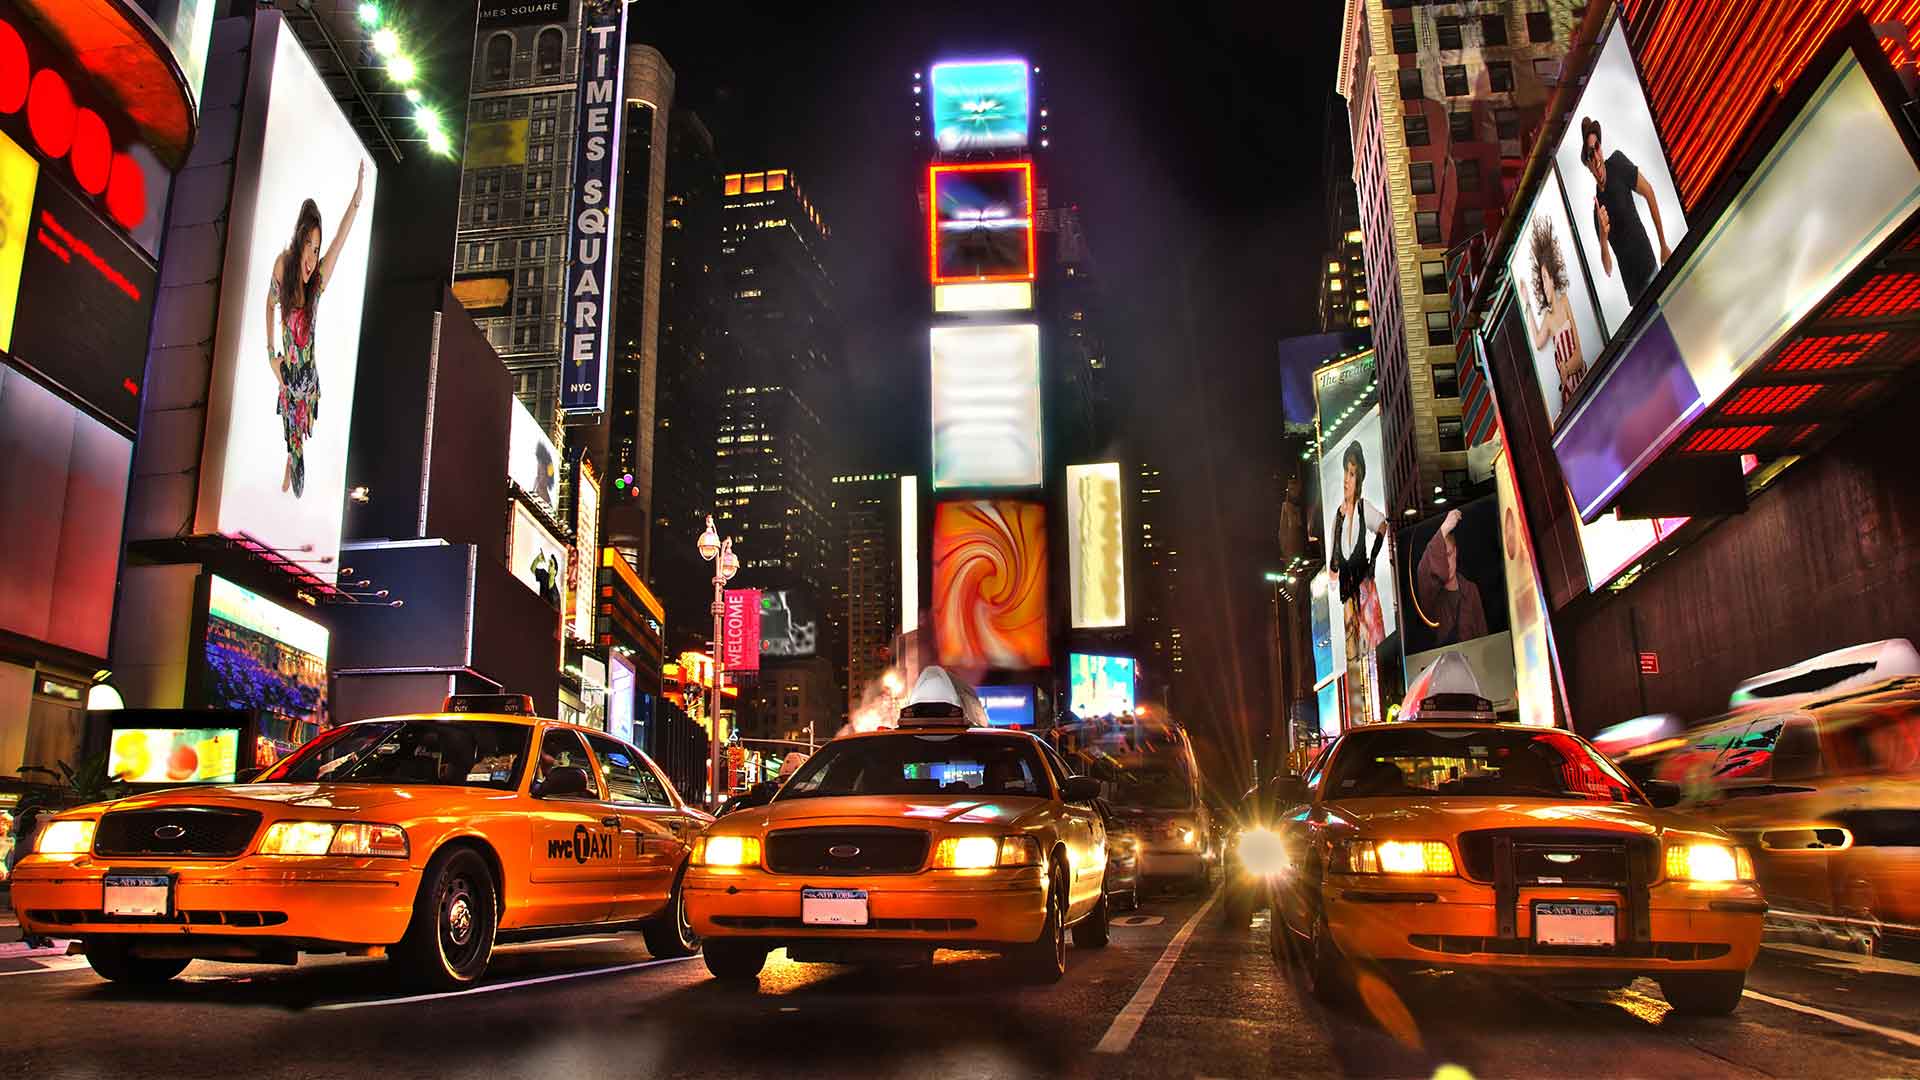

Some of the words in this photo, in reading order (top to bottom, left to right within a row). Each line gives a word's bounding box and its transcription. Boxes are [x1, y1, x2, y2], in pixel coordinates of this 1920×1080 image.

[480, 9, 507, 17] IMES
[511, 3, 559, 15] SQUARE
[586, 26, 617, 161] TIMES
[573, 179, 606, 360] SQUARE
[570, 383, 592, 392] NYC
[1320, 371, 1336, 387] The
[728, 596, 744, 667] WELCOME
[548, 840, 573, 858] NYC
[574, 826, 612, 862] TAXI
